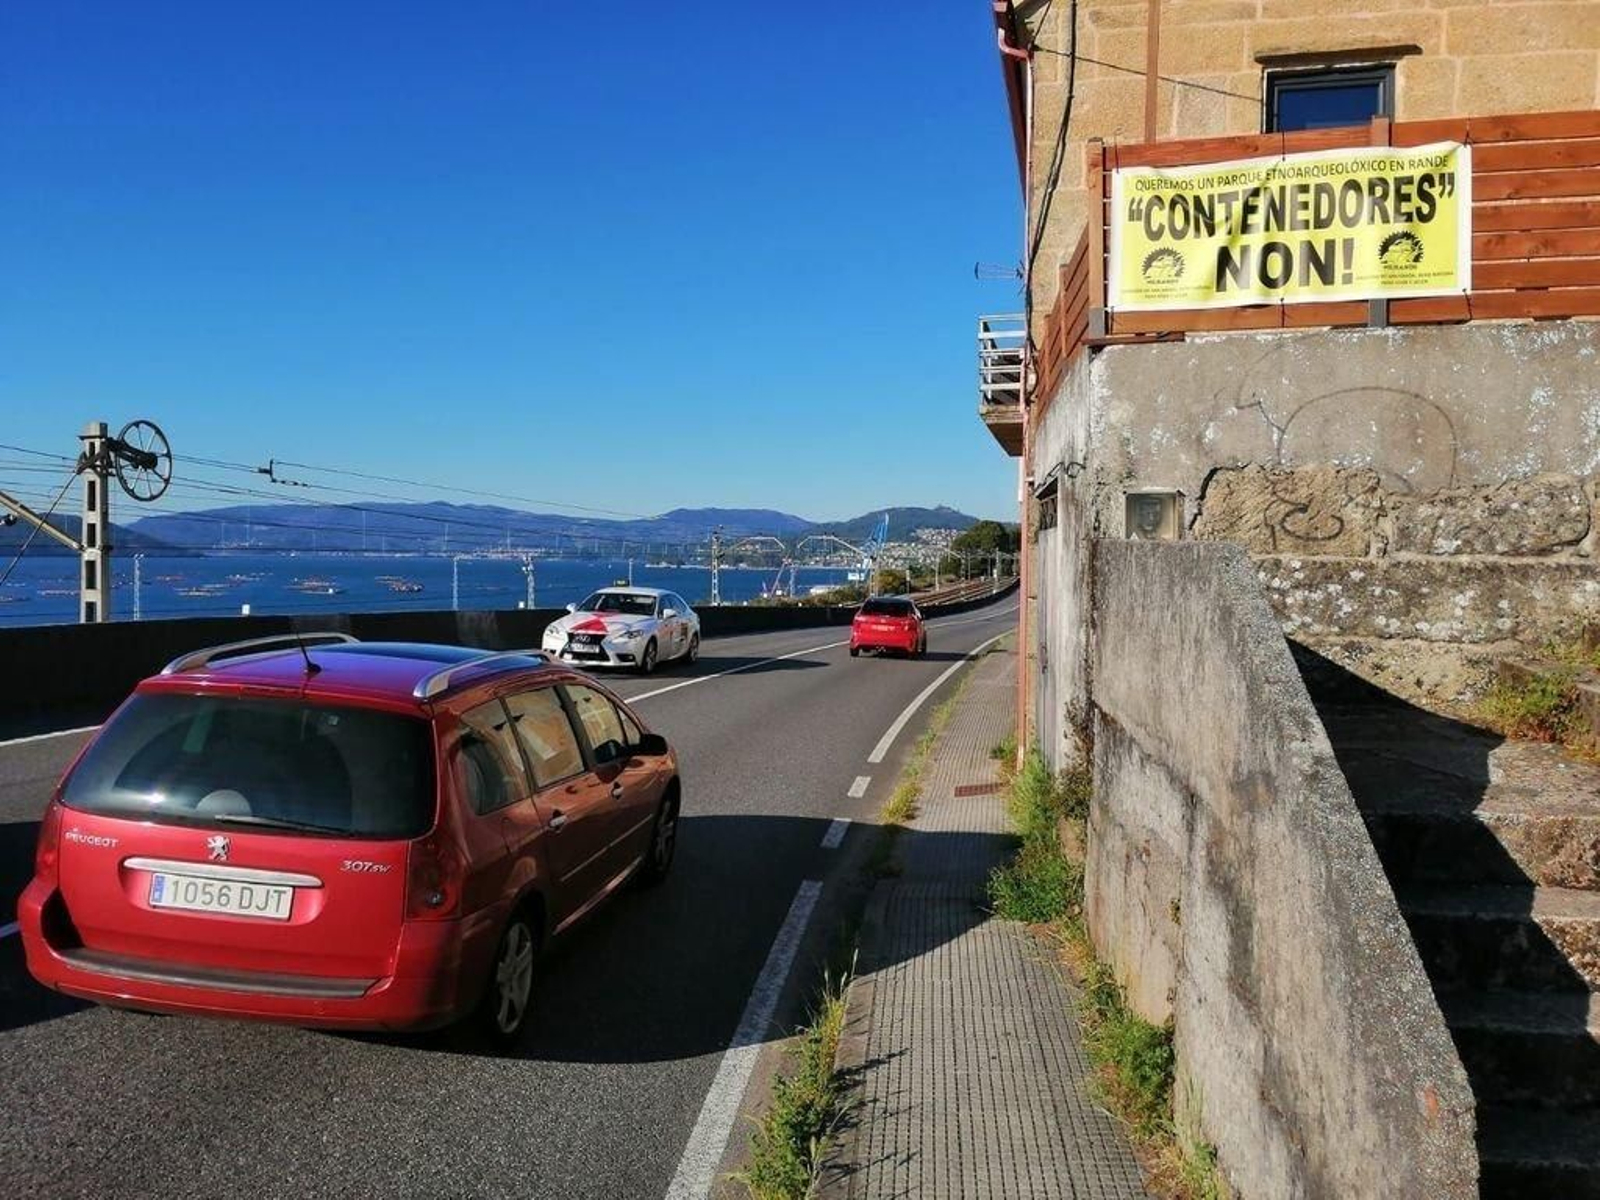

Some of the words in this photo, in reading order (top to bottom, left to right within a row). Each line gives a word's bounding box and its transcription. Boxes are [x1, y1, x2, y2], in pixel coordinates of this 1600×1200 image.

[1135, 178, 1195, 192] QUEREMOS
[1197, 177, 1215, 190] UN
[1217, 171, 1262, 188] PARQUE
[1265, 158, 1387, 181] ETNOARQUEOLÓXICO
[1389, 160, 1406, 172] EN
[1408, 155, 1449, 170] RANDE
[1215, 237, 1355, 293] NON!
[65, 829, 119, 848] PEUGEOT
[171, 879, 233, 908] 1056
[239, 885, 287, 914] DJT
